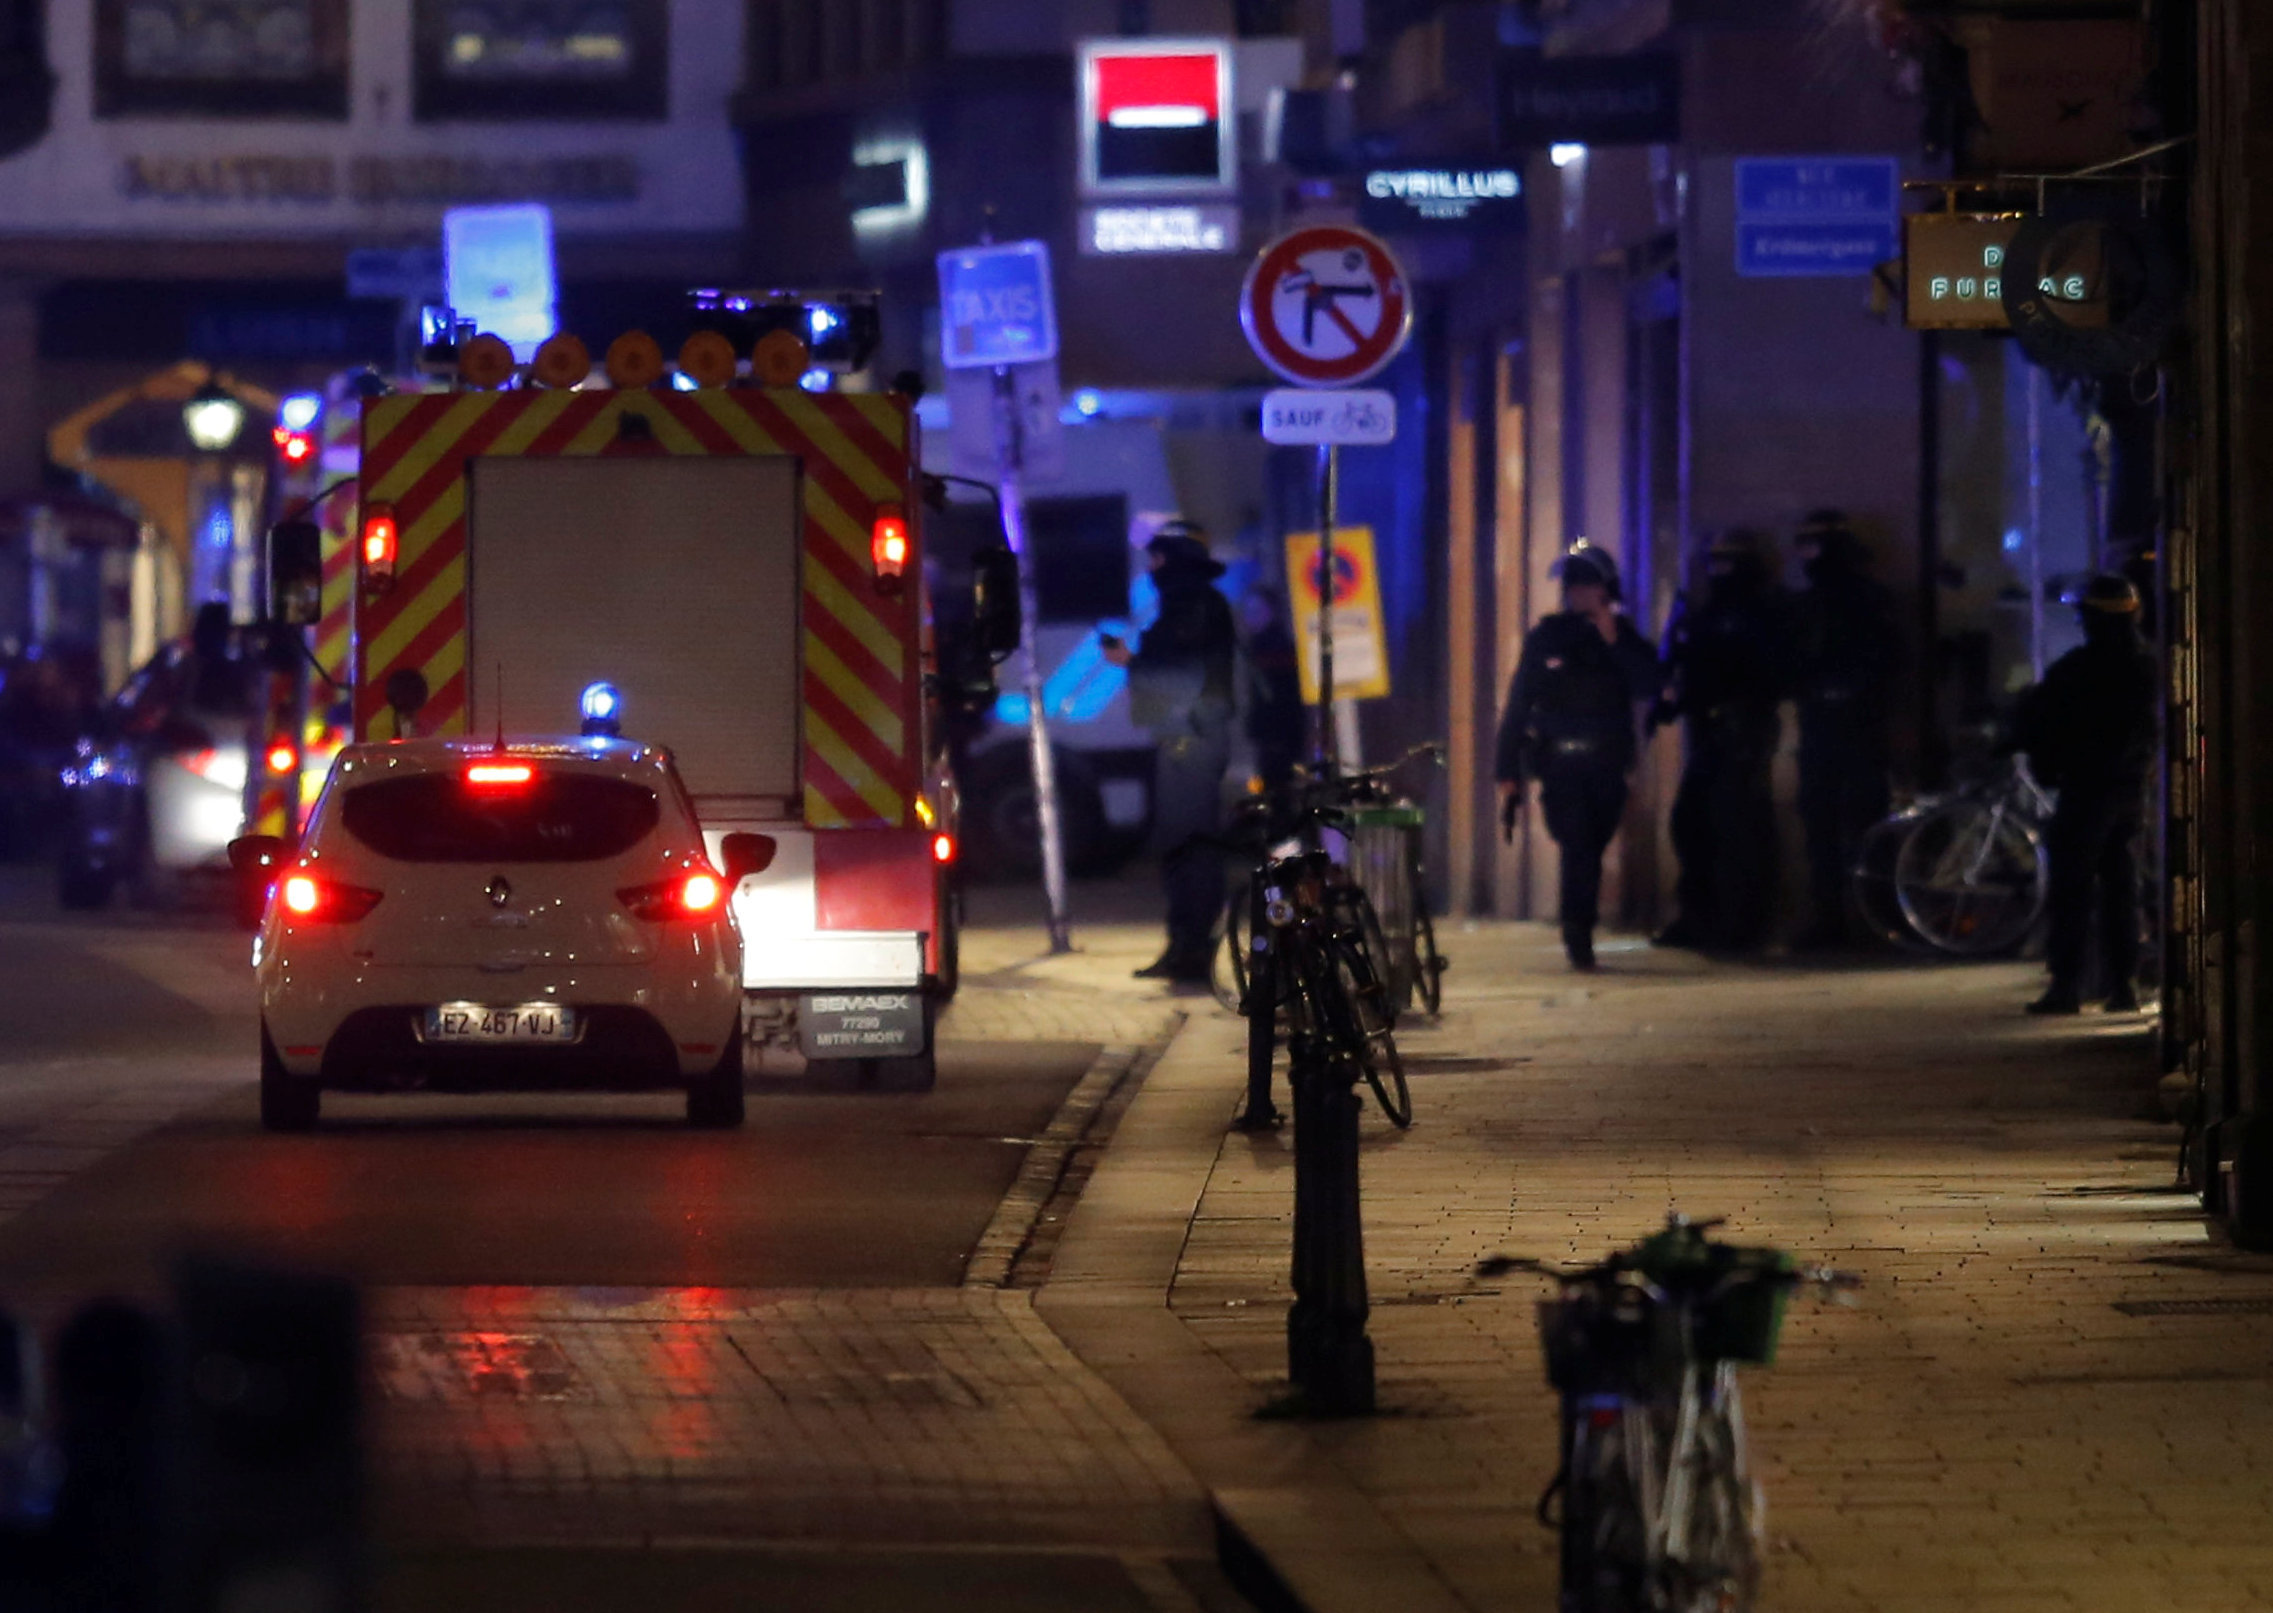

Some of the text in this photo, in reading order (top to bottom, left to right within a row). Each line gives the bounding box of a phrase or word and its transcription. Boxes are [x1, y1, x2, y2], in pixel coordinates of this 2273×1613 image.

[1366, 169, 1521, 199] CYRILLUS
[1983, 246, 2003, 268] D
[1930, 275, 2086, 300] FURAC
[952, 284, 1039, 322] TAXIS
[1272, 409, 1324, 428] SAUF
[816, 1031, 905, 1046] MITRY-MORY
